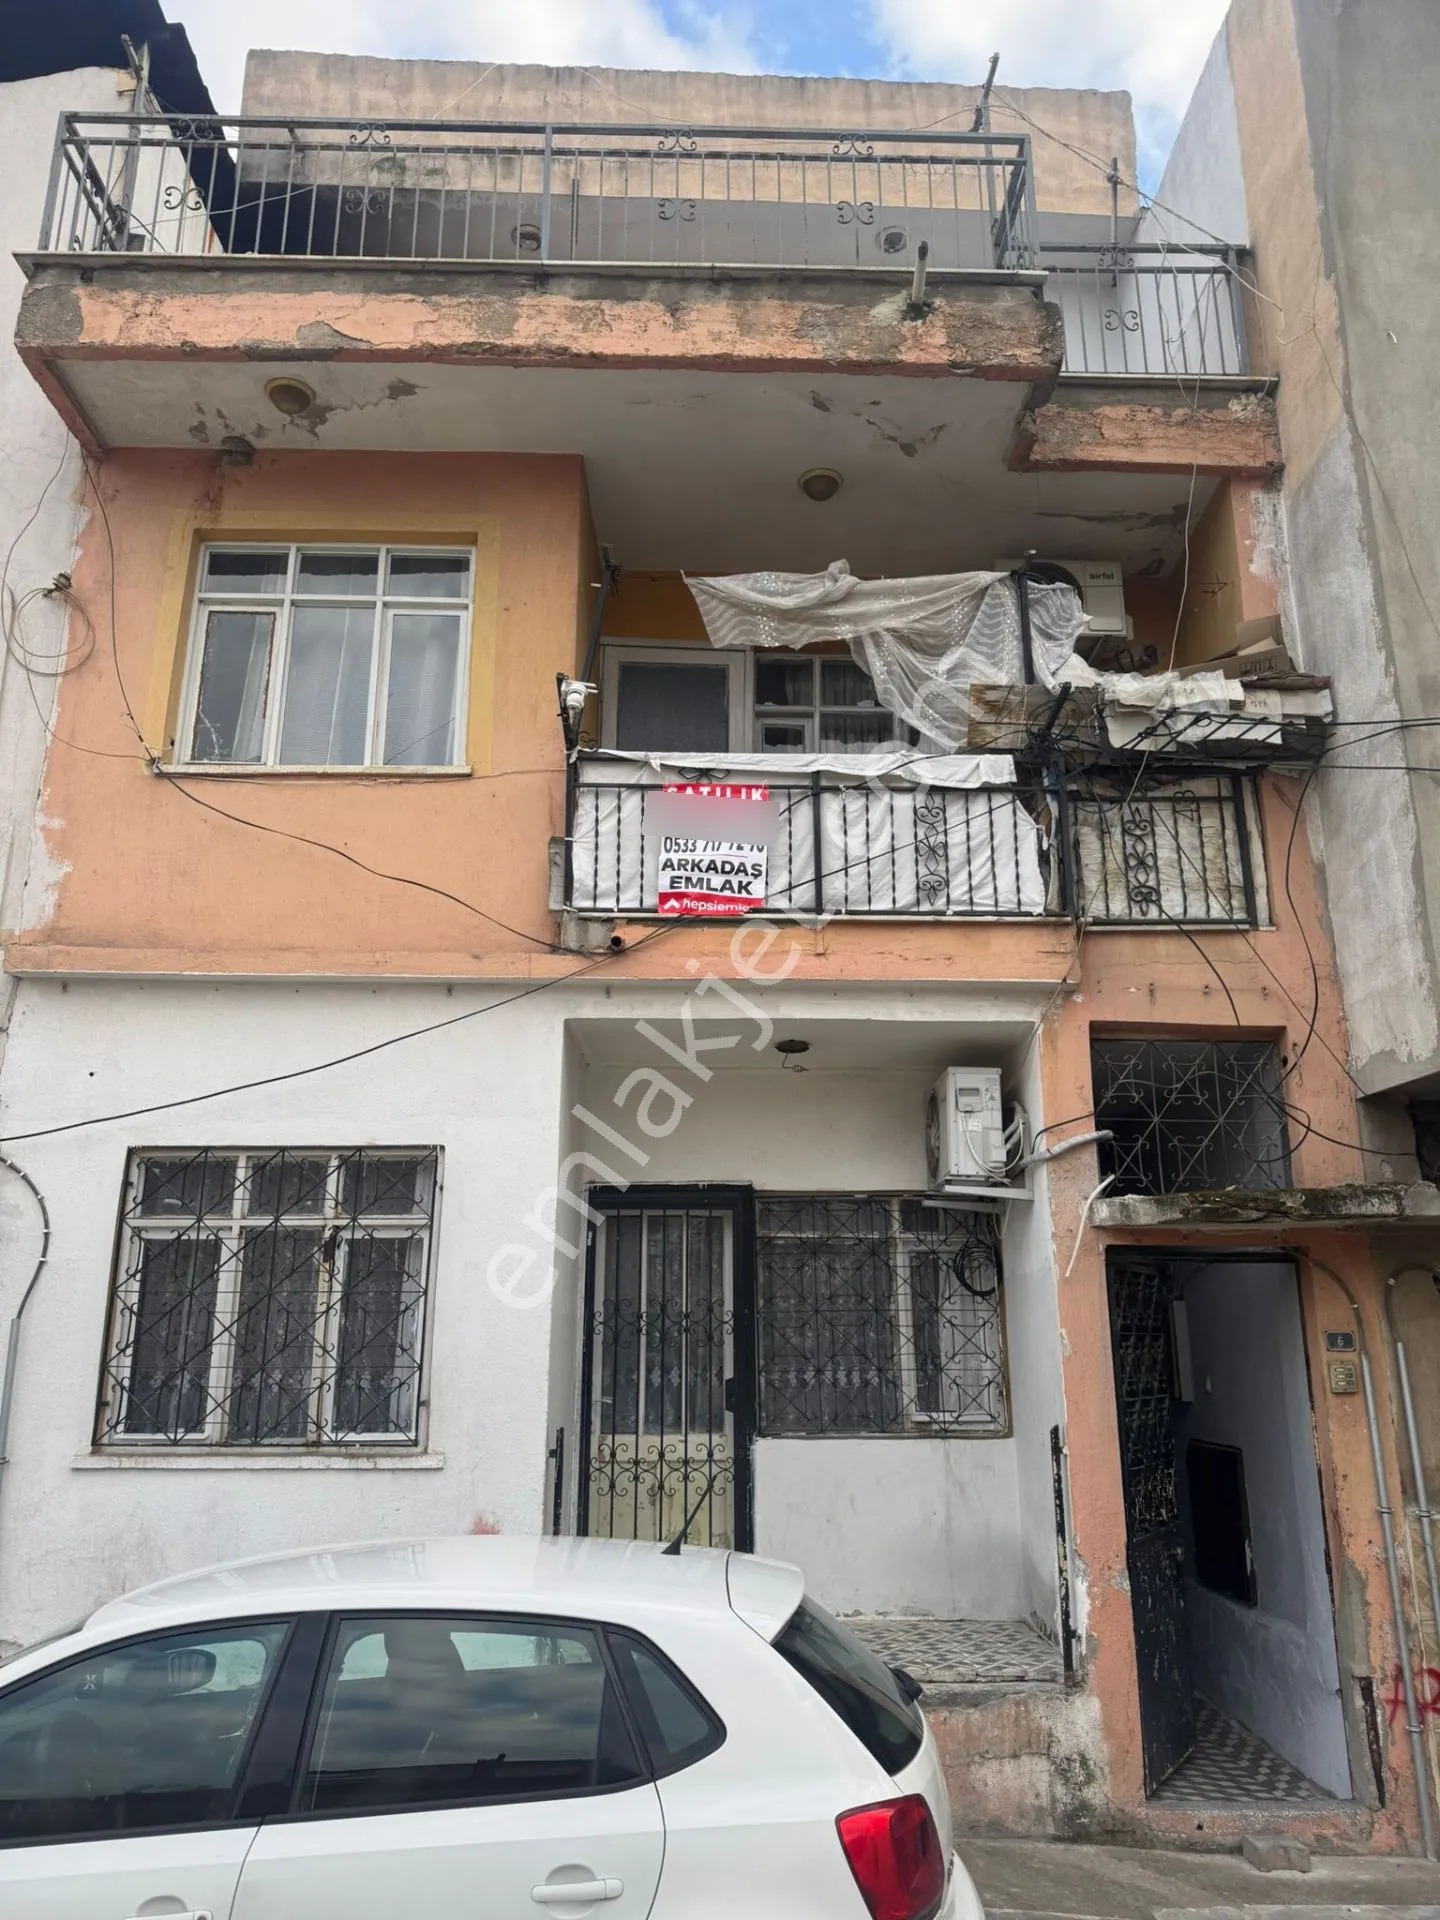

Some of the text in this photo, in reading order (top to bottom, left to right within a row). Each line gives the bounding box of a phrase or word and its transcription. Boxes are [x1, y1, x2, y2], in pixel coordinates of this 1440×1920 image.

[663, 836, 697, 854] 0533
[661, 857, 763, 880] ARKADAŞ
[669, 876, 753, 896] EMLAK
[1337, 1335, 1344, 1346] 6
